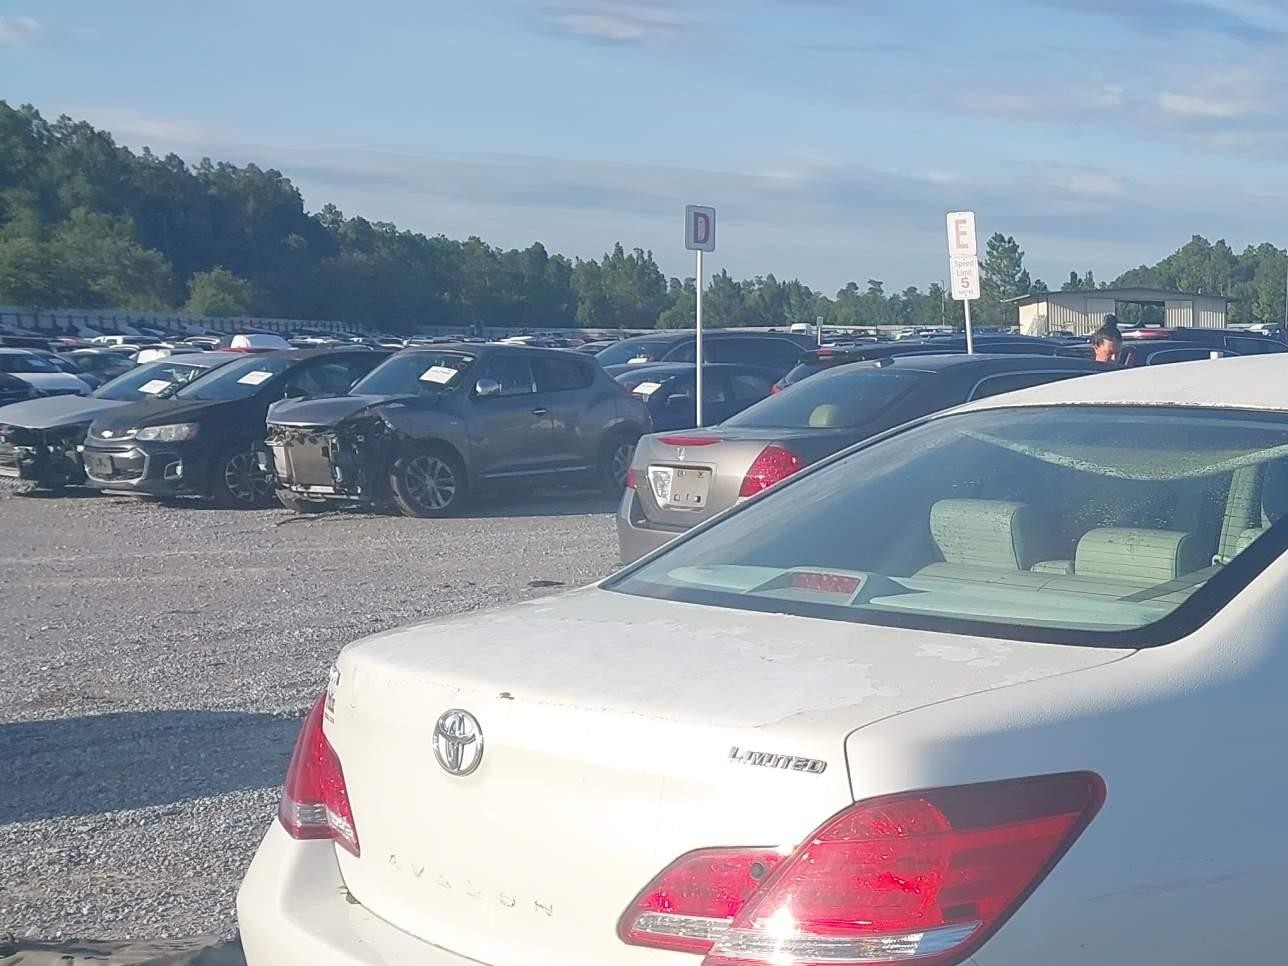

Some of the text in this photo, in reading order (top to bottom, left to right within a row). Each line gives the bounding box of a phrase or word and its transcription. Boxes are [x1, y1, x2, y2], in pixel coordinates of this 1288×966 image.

[693, 211, 710, 244] D
[955, 219, 969, 249] E
[954, 260, 975, 269] Speed
[960, 277, 970, 289] 5
[729, 746, 828, 774] LIMITED
